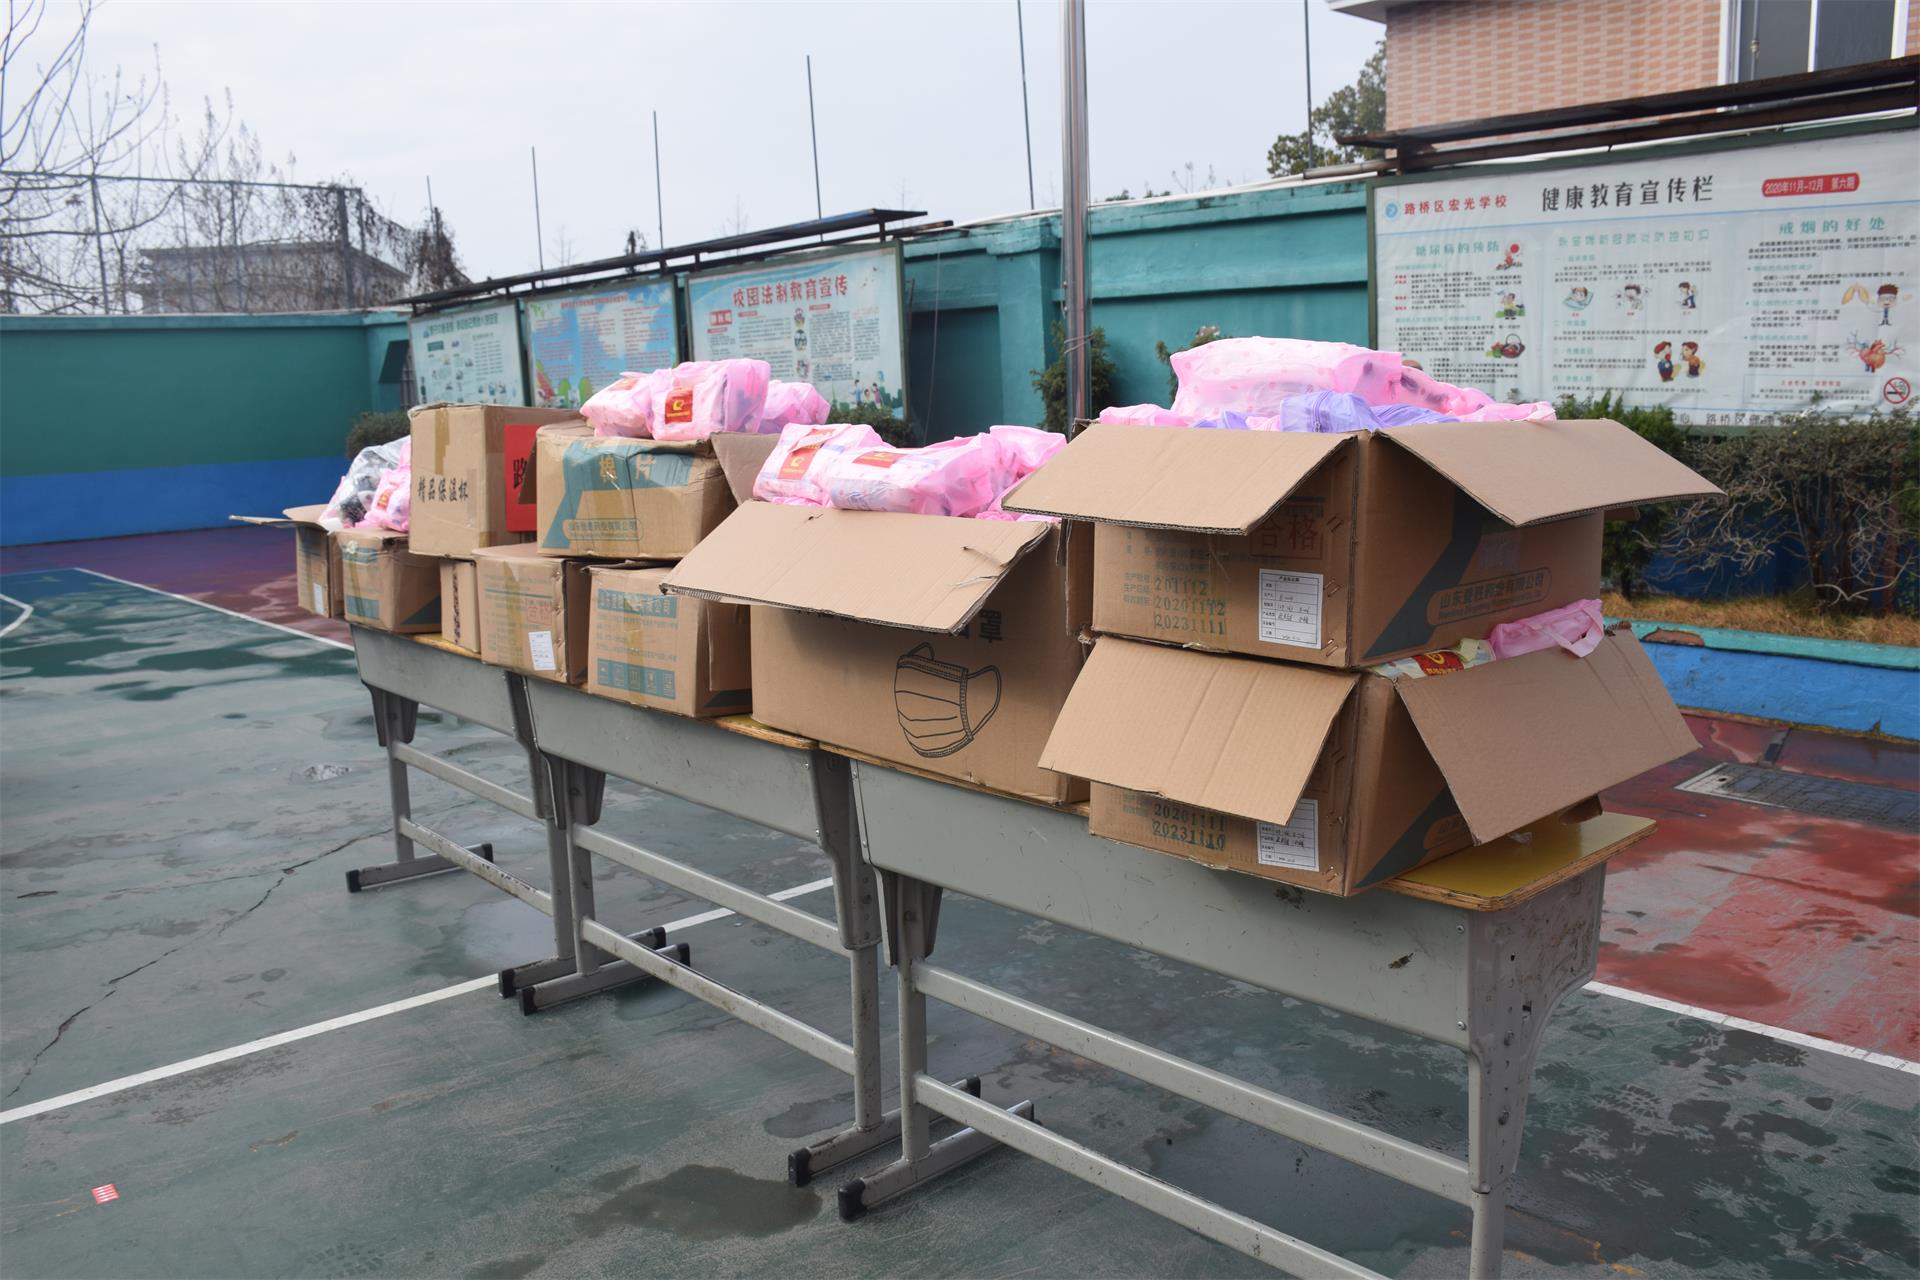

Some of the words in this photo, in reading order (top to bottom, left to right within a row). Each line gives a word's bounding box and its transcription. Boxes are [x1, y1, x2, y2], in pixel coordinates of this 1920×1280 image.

[1542, 174, 1713, 212] 健康教育宣传栏
[1831, 176, 1856, 192] 第六期
[1404, 195, 1508, 216] 路桥区宏光学校
[1779, 216, 1885, 235] 戒烟的好处
[733, 274, 848, 308] 校园法制教育宣传
